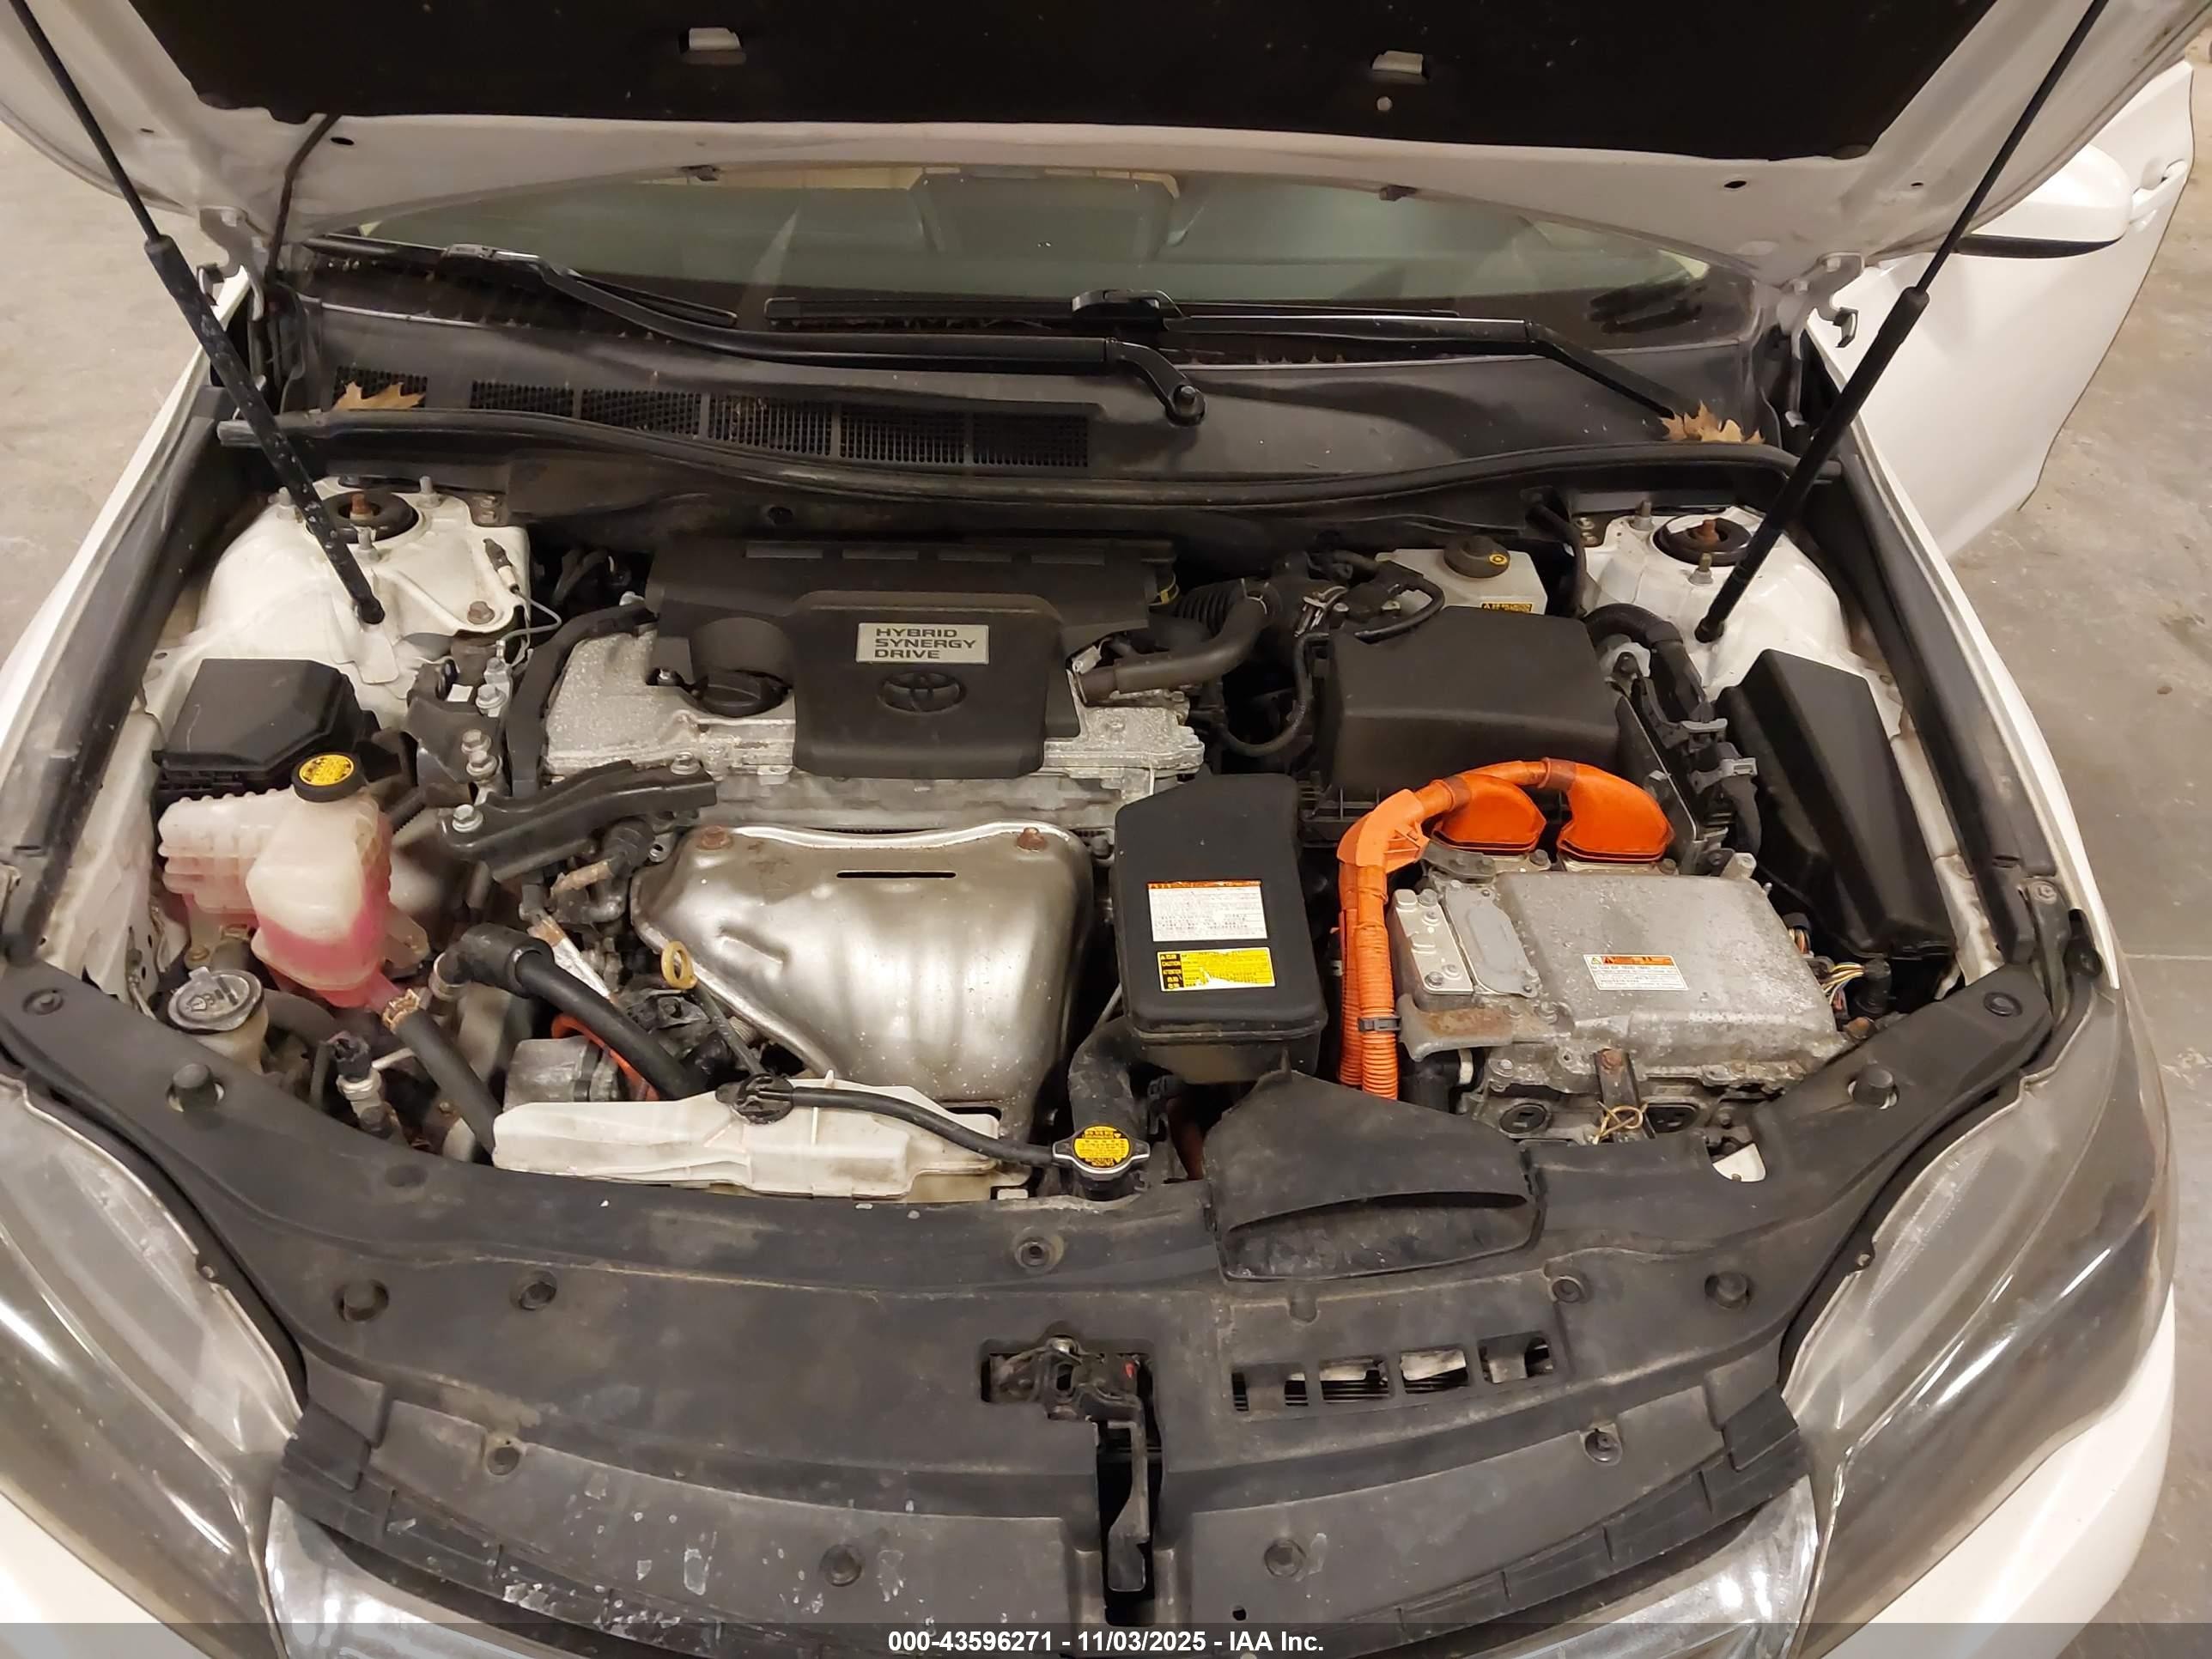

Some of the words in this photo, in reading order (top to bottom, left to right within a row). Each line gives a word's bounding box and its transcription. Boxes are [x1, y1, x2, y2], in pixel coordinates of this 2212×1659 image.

[876, 628, 957, 637] HYBRID
[875, 638, 976, 648] SYNERGY
[874, 649, 940, 659] DRIVE
